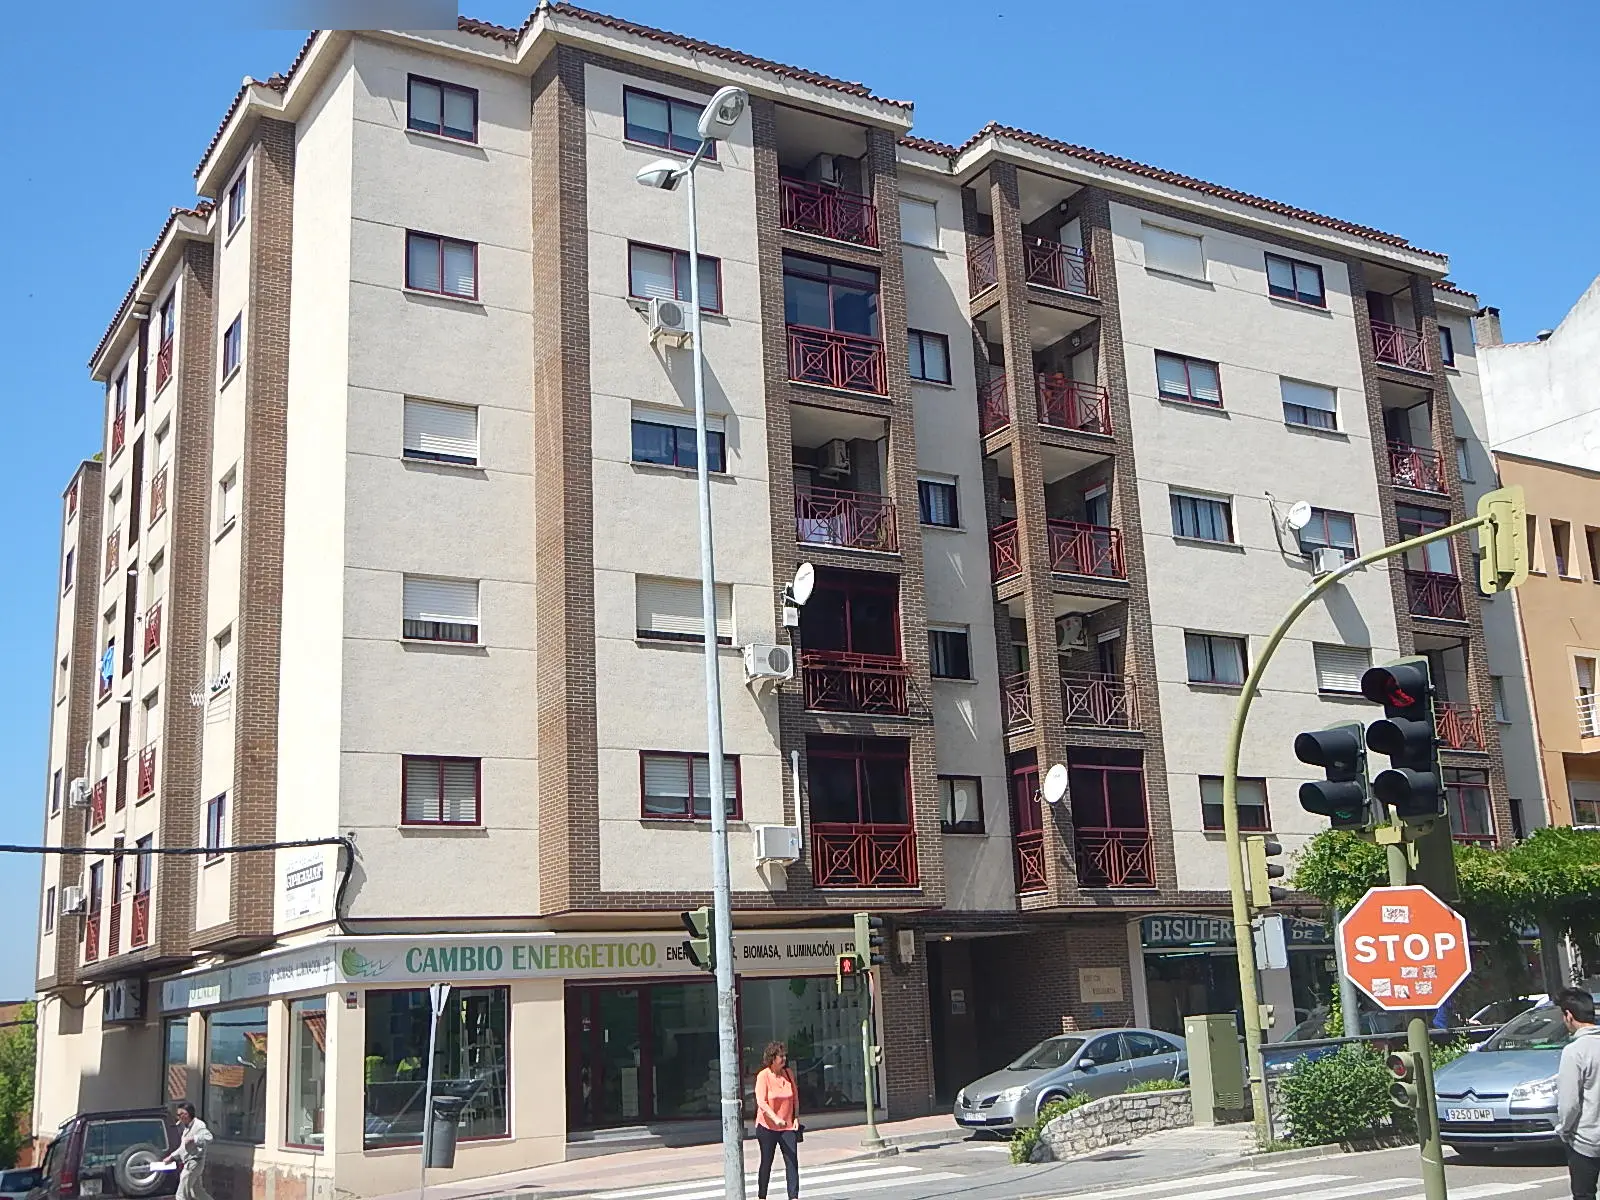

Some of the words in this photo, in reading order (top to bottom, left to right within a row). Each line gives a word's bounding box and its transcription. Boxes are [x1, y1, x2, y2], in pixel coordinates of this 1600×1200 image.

[1151, 918, 1234, 941] BISUTER
[743, 947, 781, 960] BIOMASA,
[787, 941, 835, 959] ILUMINACIÓN
[1354, 932, 1457, 963] STOP
[405, 945, 503, 974] CAMBIO
[1450, 1109, 1472, 1120] 9250
